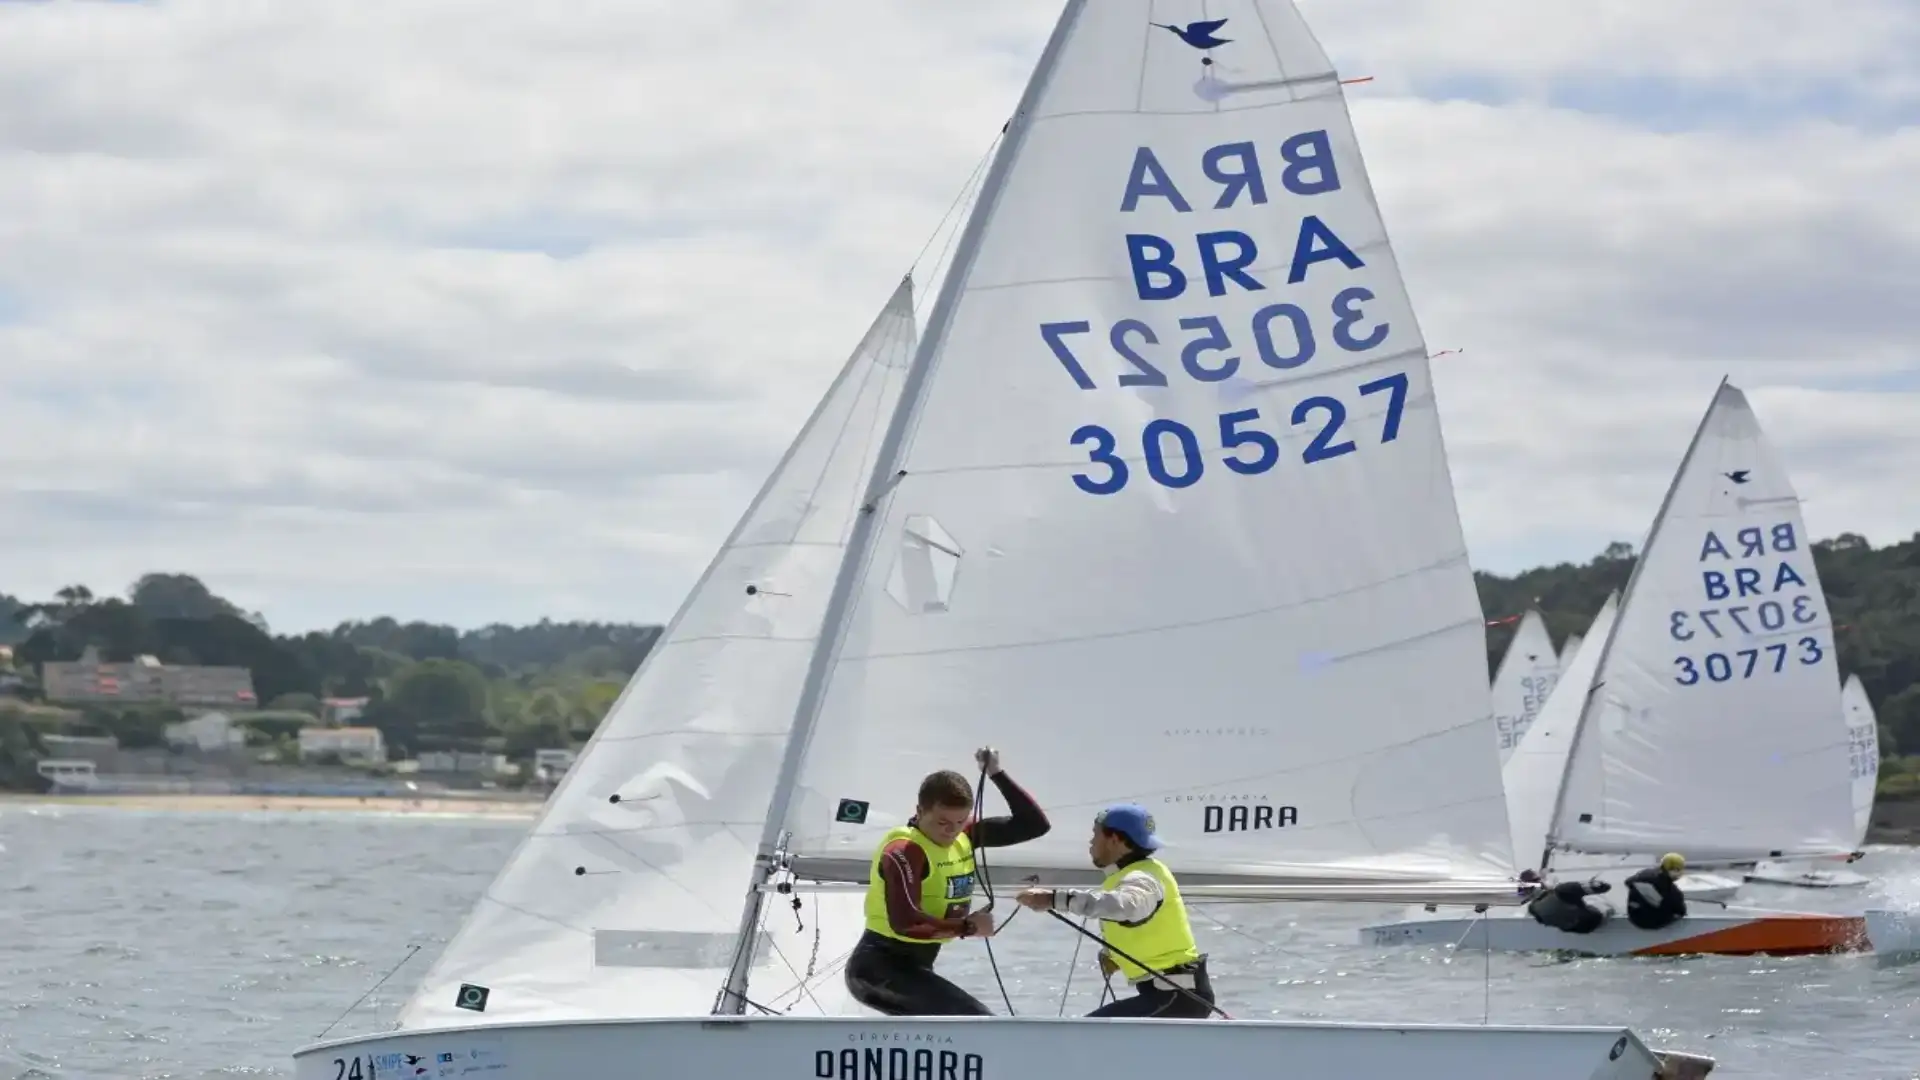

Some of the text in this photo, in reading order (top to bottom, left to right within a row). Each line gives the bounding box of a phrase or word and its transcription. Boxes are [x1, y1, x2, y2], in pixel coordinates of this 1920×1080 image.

[1125, 215, 1366, 301] BRA
[1070, 372, 1409, 496] 30527
[1703, 561, 1806, 601] BRA
[1673, 637, 1824, 686] 30773
[1203, 805, 1298, 833] DARA
[848, 1032, 954, 1044] CERVEJARIA
[333, 1056, 364, 1080] 24
[815, 1047, 984, 1080] DANDARA
